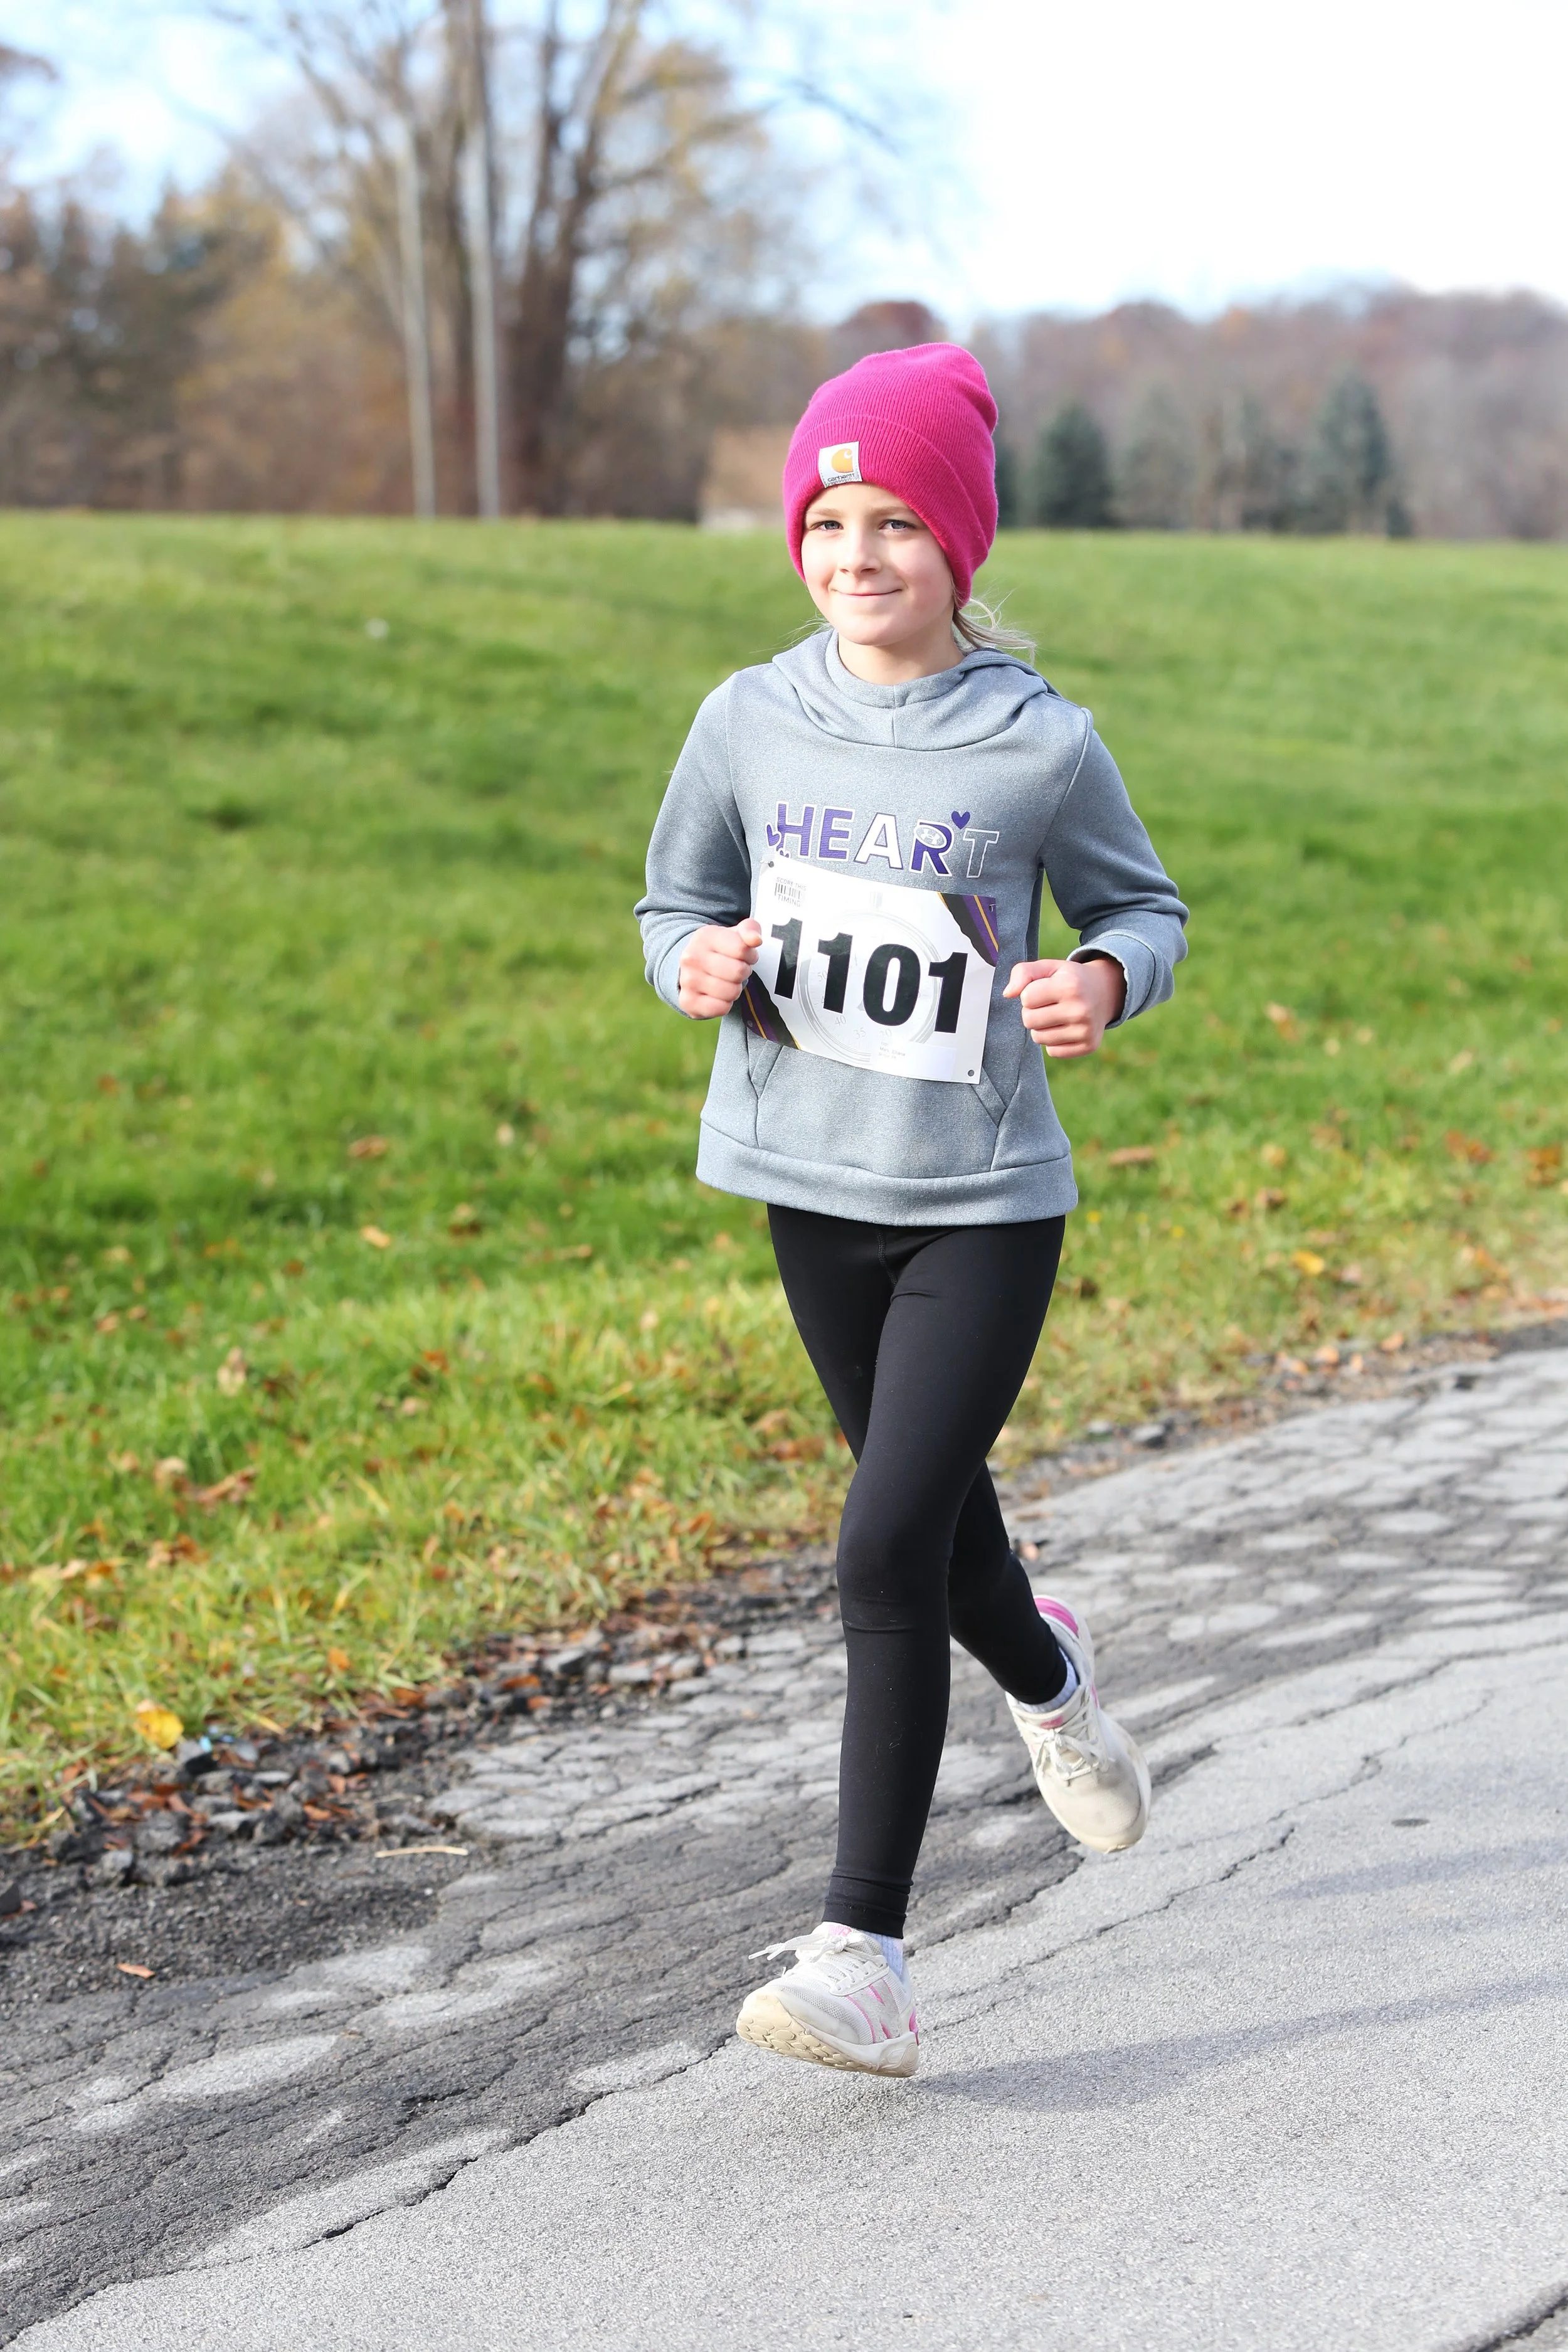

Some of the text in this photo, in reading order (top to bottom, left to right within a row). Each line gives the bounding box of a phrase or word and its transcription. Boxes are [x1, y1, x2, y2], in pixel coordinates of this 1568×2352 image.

[775, 801, 1000, 878] HEART
[776, 877, 807, 891] SCORE THIS
[778, 894, 800, 908] TIMING
[771, 917, 968, 1034] 1101
[835, 1015, 847, 1026] 40
[854, 1027, 866, 1039] 35
